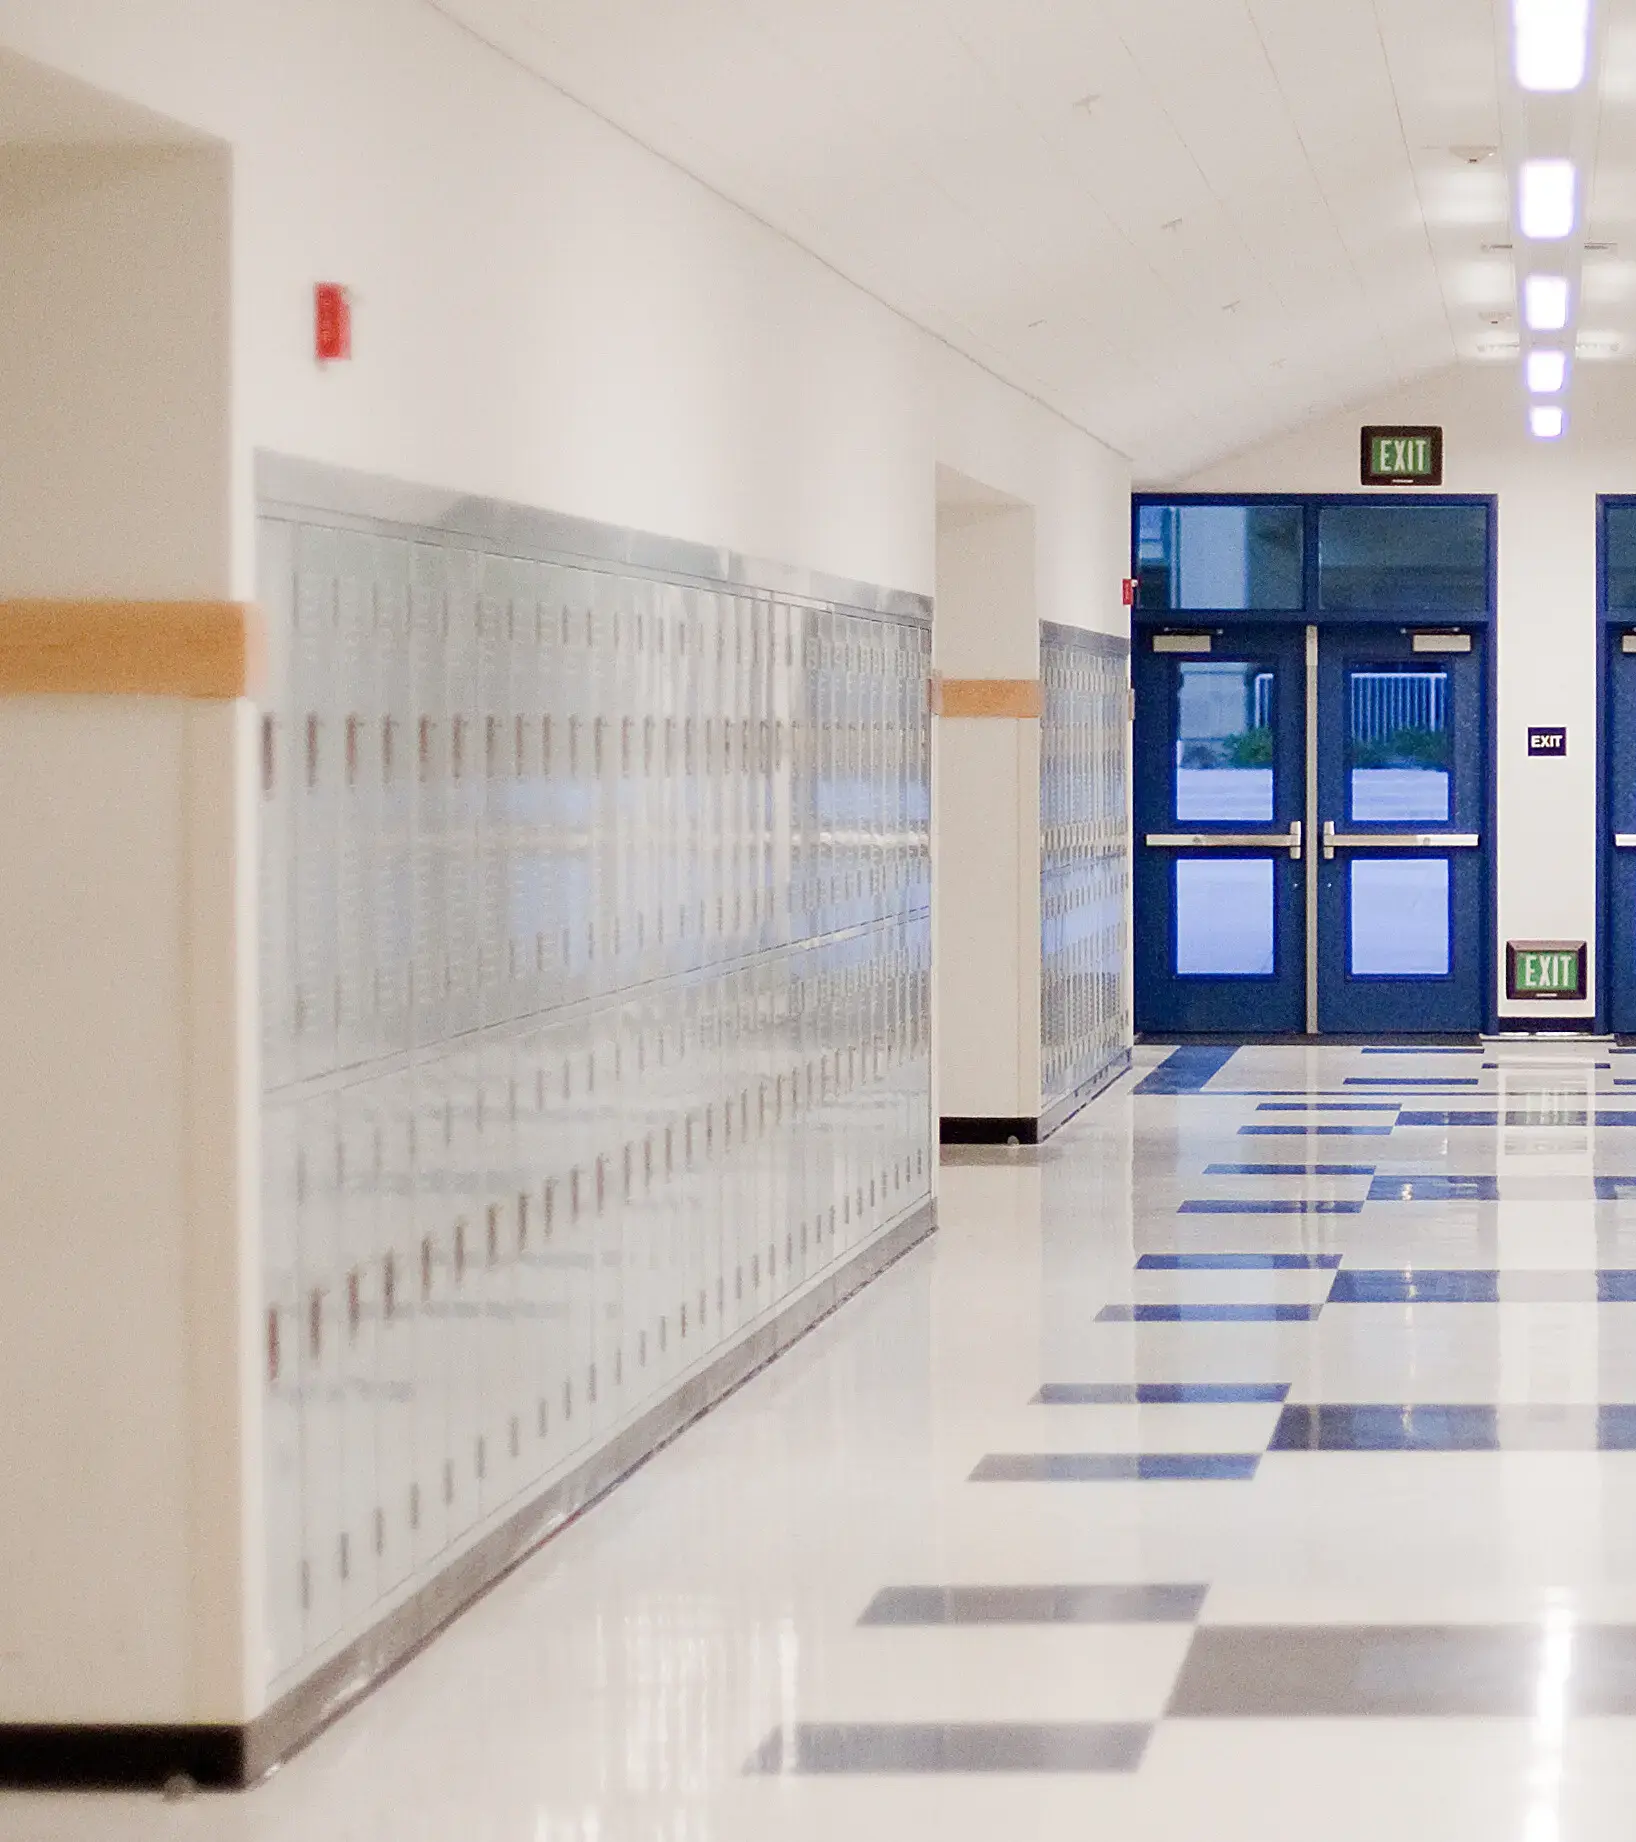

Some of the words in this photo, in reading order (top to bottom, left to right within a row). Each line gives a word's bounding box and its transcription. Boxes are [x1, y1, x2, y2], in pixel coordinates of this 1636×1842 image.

[1380, 440, 1426, 471] EXIT
[1531, 735, 1562, 748] EXIT
[1525, 955, 1571, 986] EXIT
